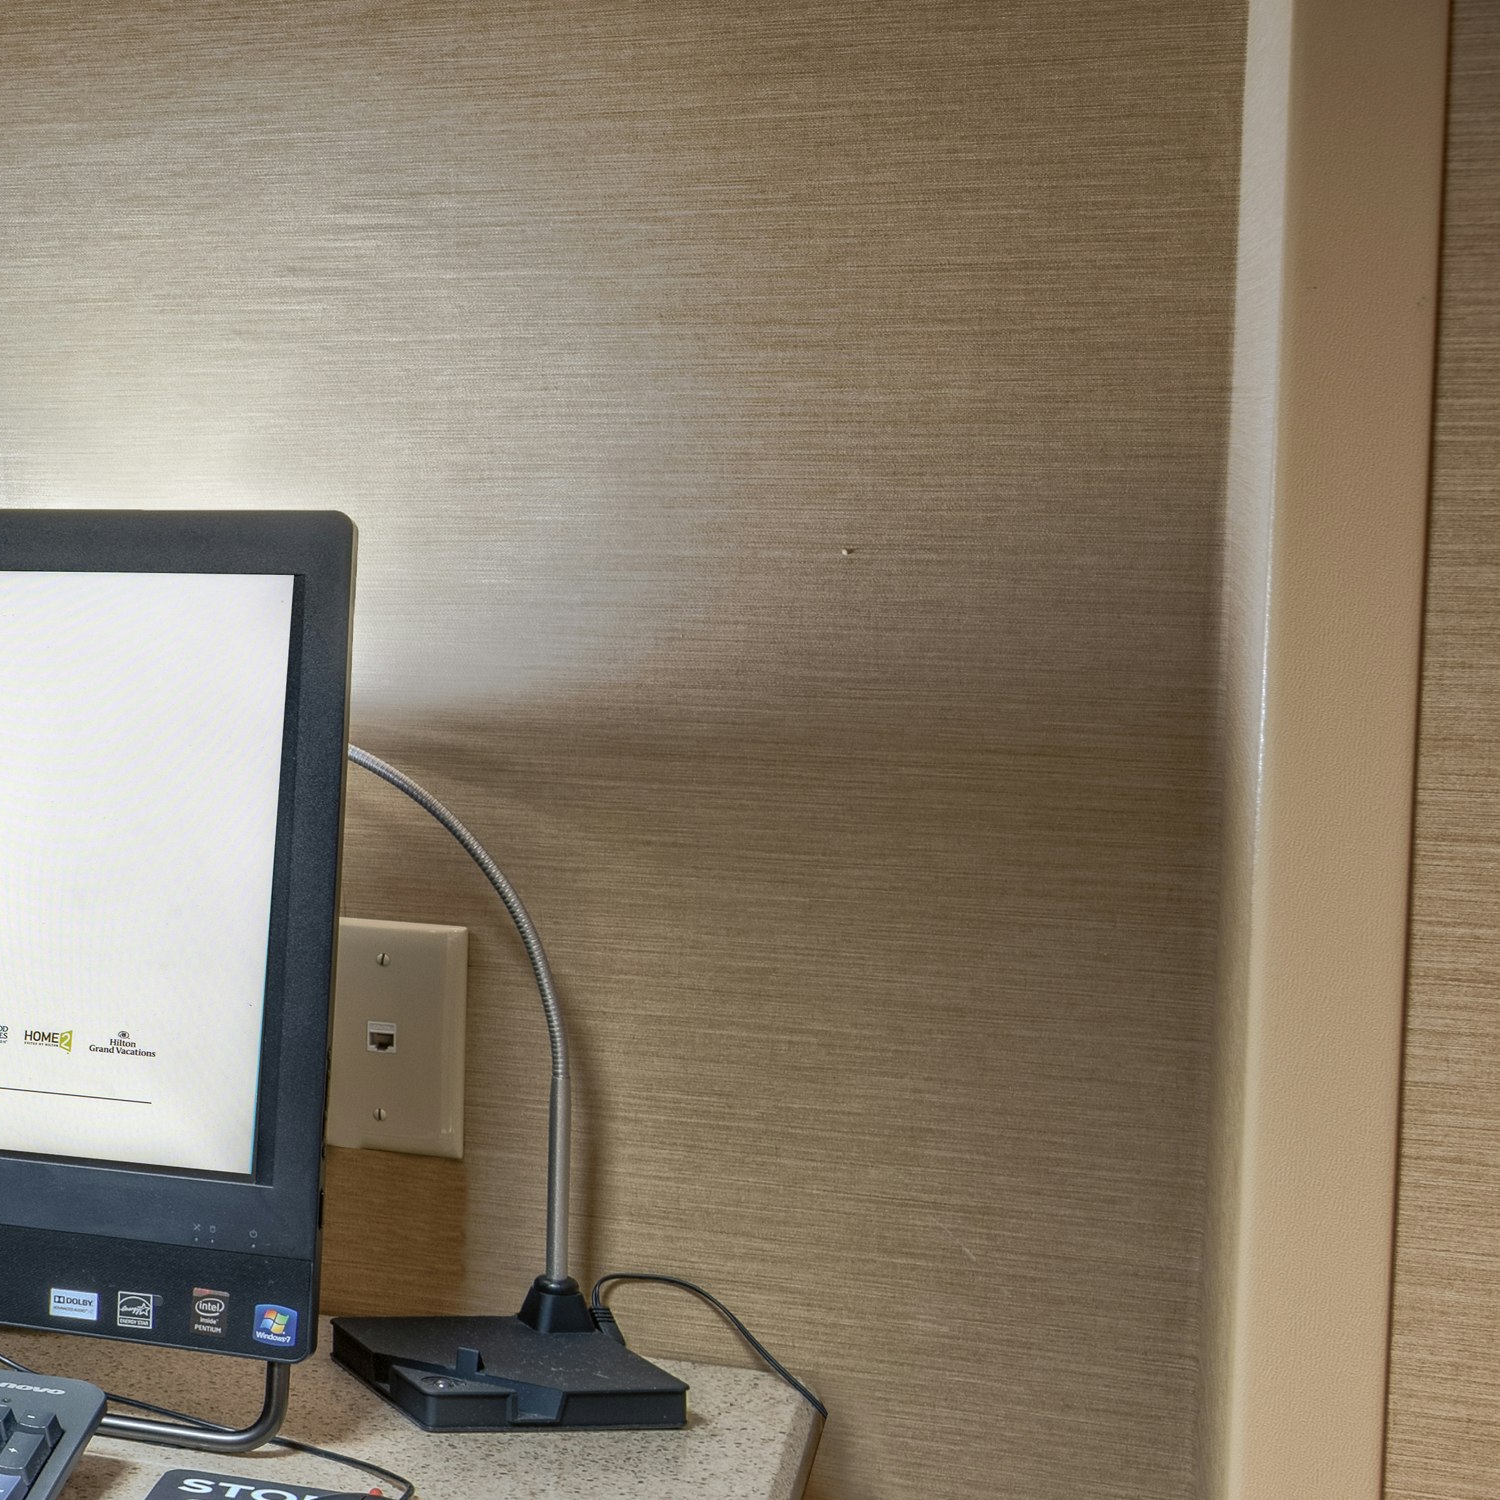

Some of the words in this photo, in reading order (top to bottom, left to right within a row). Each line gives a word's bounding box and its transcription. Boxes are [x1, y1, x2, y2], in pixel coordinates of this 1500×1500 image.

[109, 1038, 136, 1048] Hilton
[89, 1044, 115, 1053] Grand
[116, 1046, 156, 1057] Vacations
[66, 1297, 93, 1306] DOLBY
[200, 1301, 220, 1311] intel
[194, 1324, 221, 1333] PENTIUM
[256, 1331, 286, 1342] Windows
